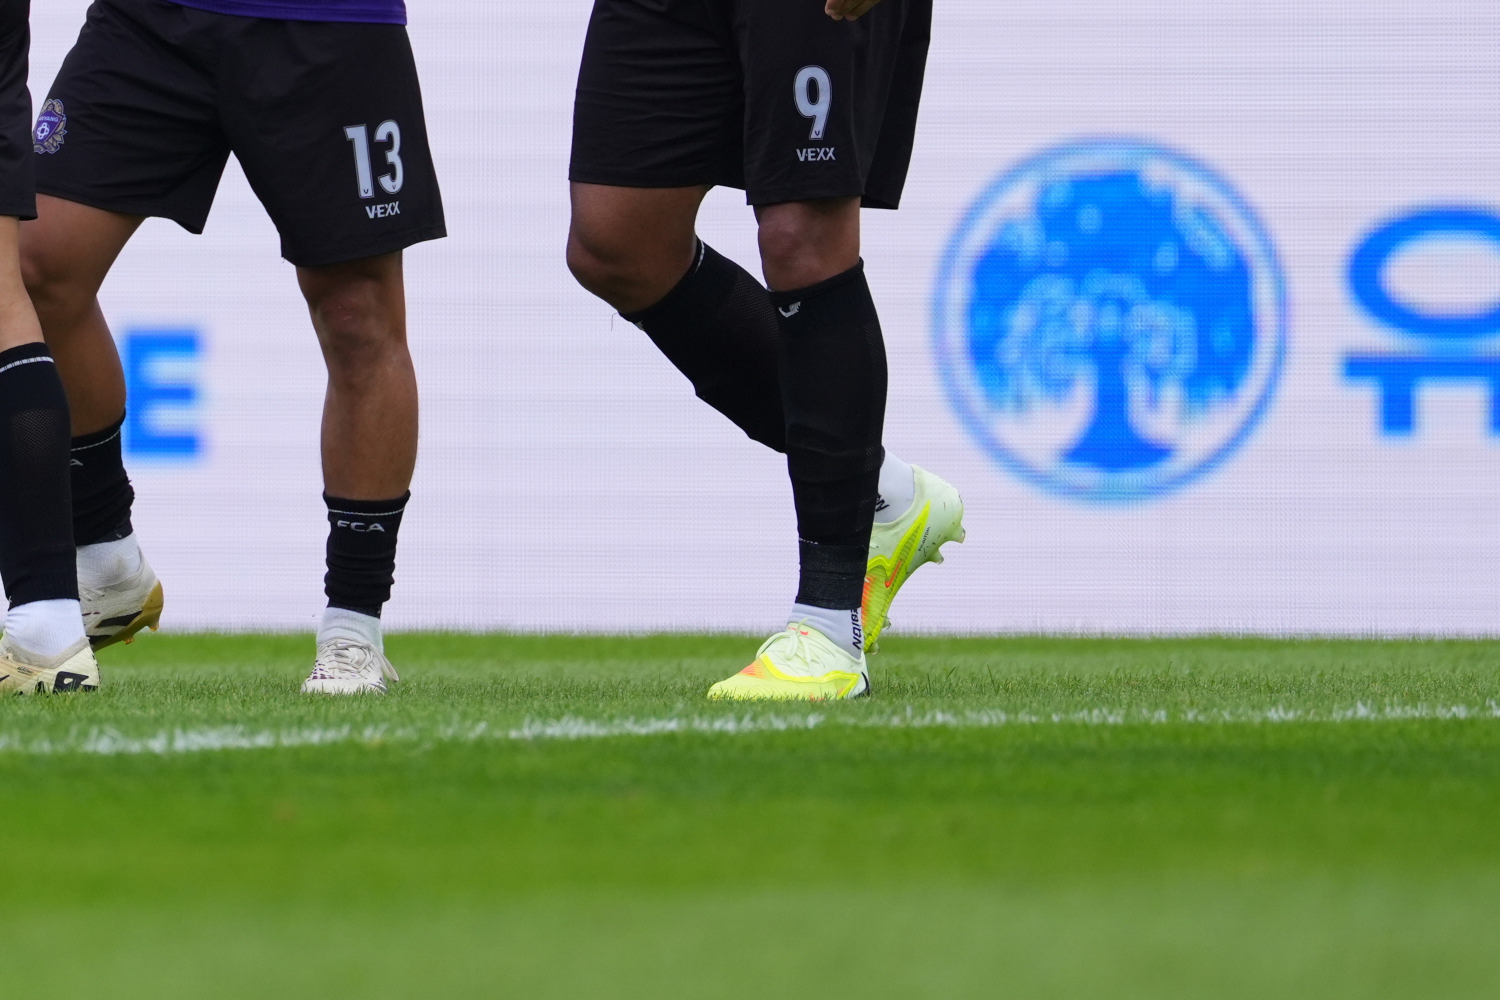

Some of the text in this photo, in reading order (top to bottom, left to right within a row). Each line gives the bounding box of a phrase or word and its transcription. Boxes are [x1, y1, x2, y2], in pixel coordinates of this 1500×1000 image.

[793, 64, 833, 140] 9
[343, 119, 404, 199] 13
[796, 147, 836, 162] VEXX
[365, 201, 401, 219] VEXX
[336, 519, 386, 533] FCA
